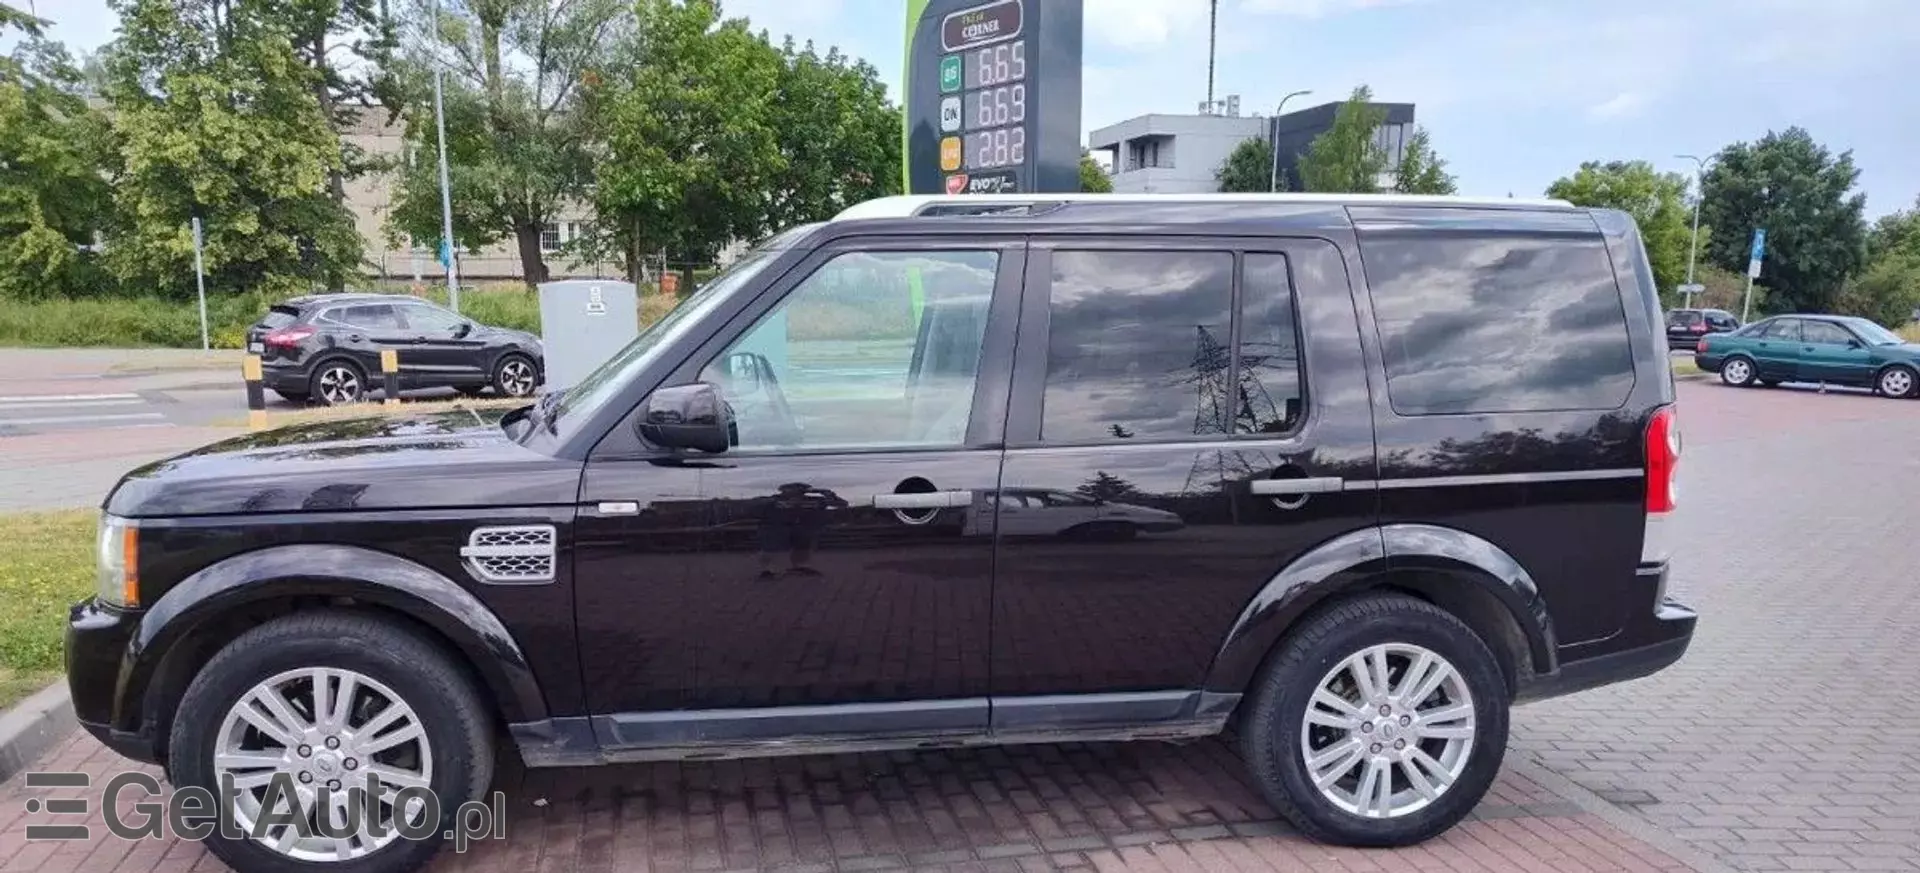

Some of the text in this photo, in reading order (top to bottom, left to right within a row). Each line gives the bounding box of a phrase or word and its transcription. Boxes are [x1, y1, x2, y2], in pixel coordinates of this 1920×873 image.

[979, 40, 1025, 85] 6.65
[944, 107, 957, 121] ON
[979, 84, 1025, 125] 6.69
[979, 126, 1025, 167] 2.82
